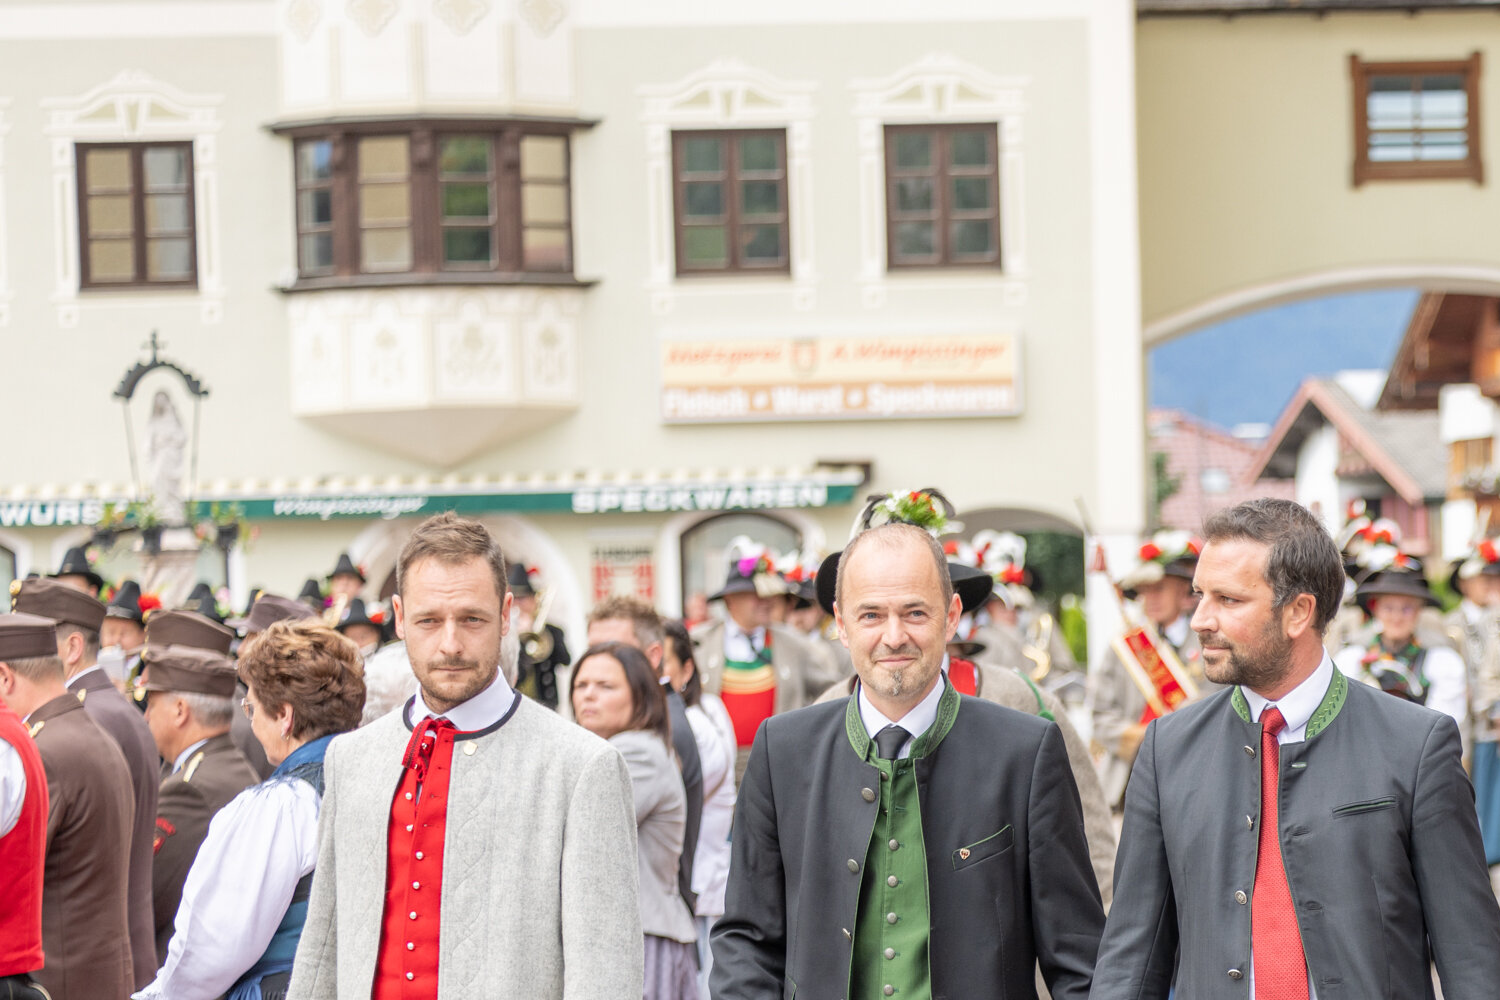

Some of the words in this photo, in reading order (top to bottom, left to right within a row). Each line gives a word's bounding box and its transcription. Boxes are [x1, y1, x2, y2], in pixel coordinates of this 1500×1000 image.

[663, 386, 746, 417] Fleisch
[771, 384, 843, 414] Wurst
[572, 484, 828, 513] SPECKWAREN
